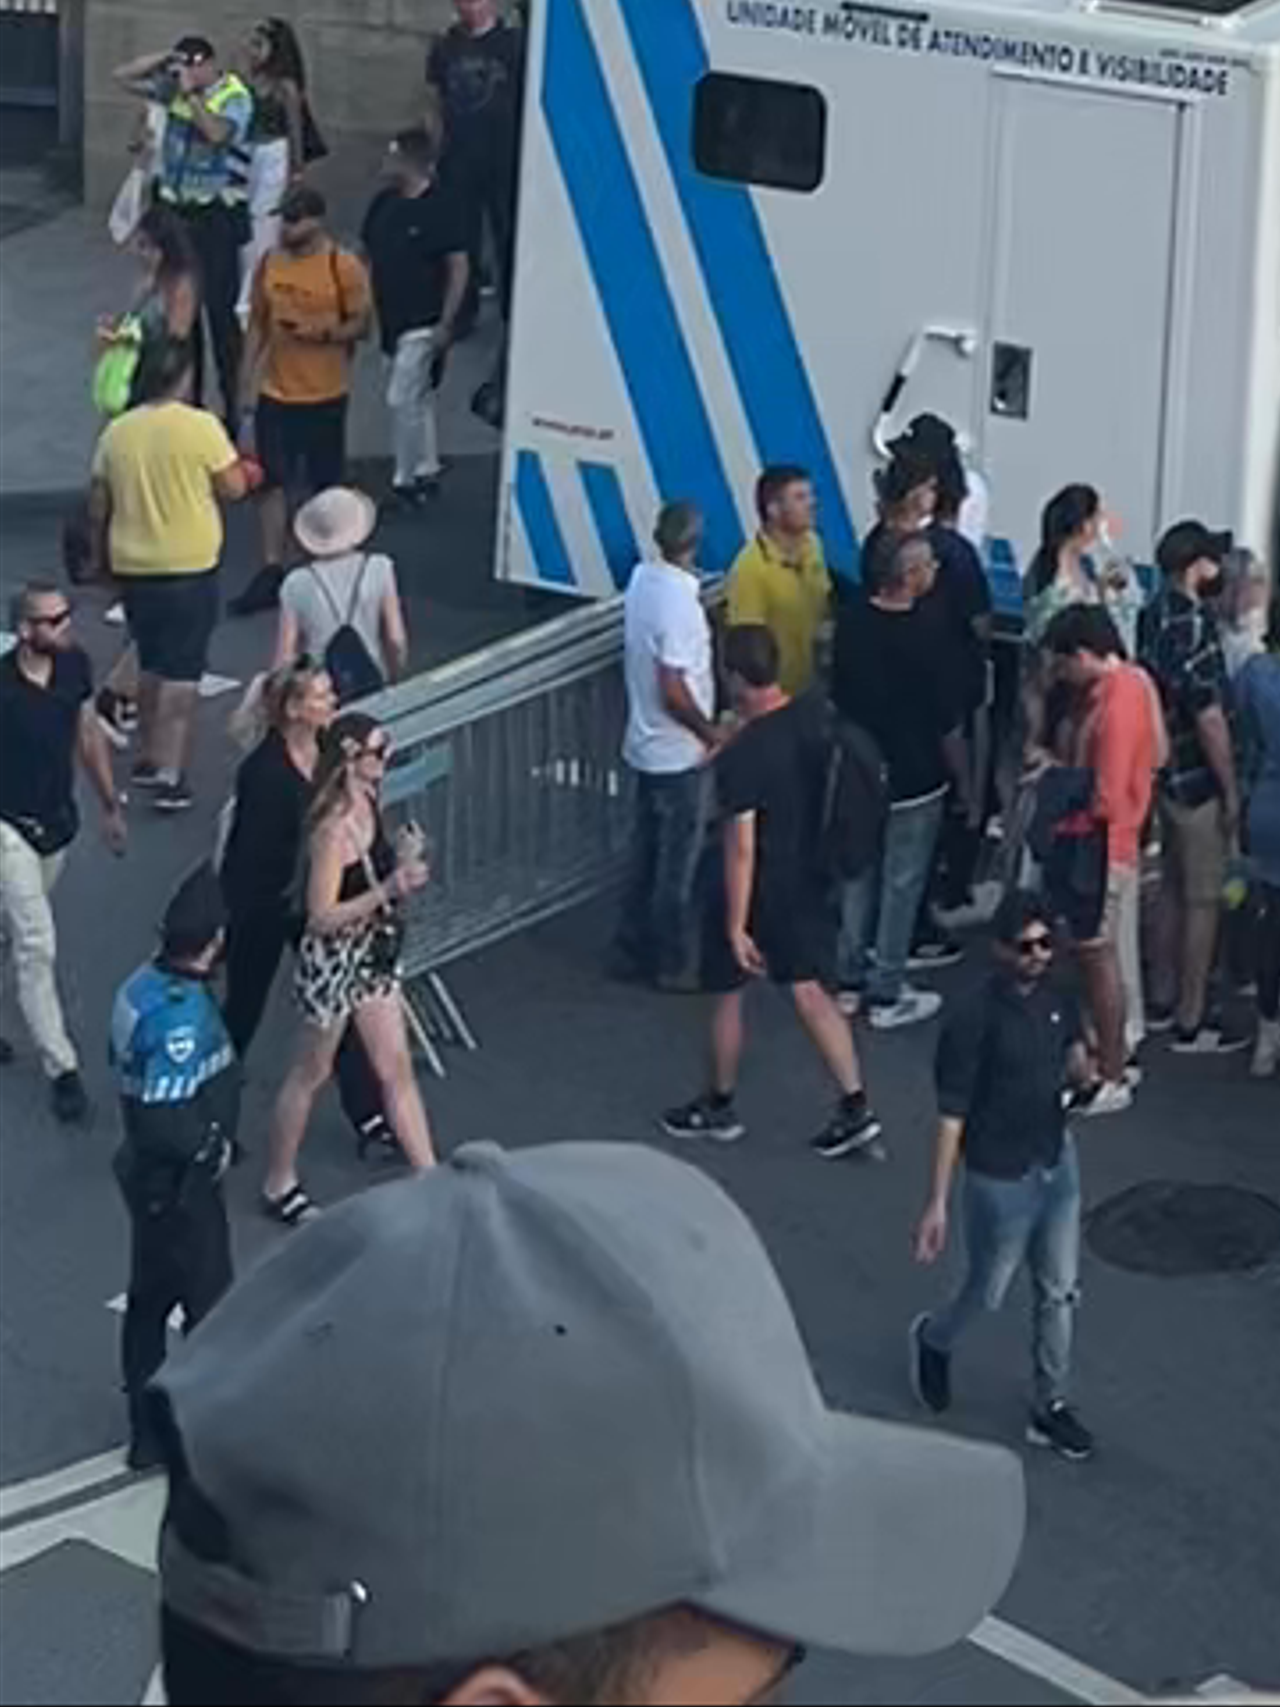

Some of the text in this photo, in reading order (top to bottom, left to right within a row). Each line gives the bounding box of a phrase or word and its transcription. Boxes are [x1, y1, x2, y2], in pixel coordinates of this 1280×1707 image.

[897, 23, 922, 52] DE
[927, 29, 1074, 73] ATENDIMENTO
[1078, 48, 1090, 75] E
[1098, 53, 1229, 97] VISIBILIDADE
